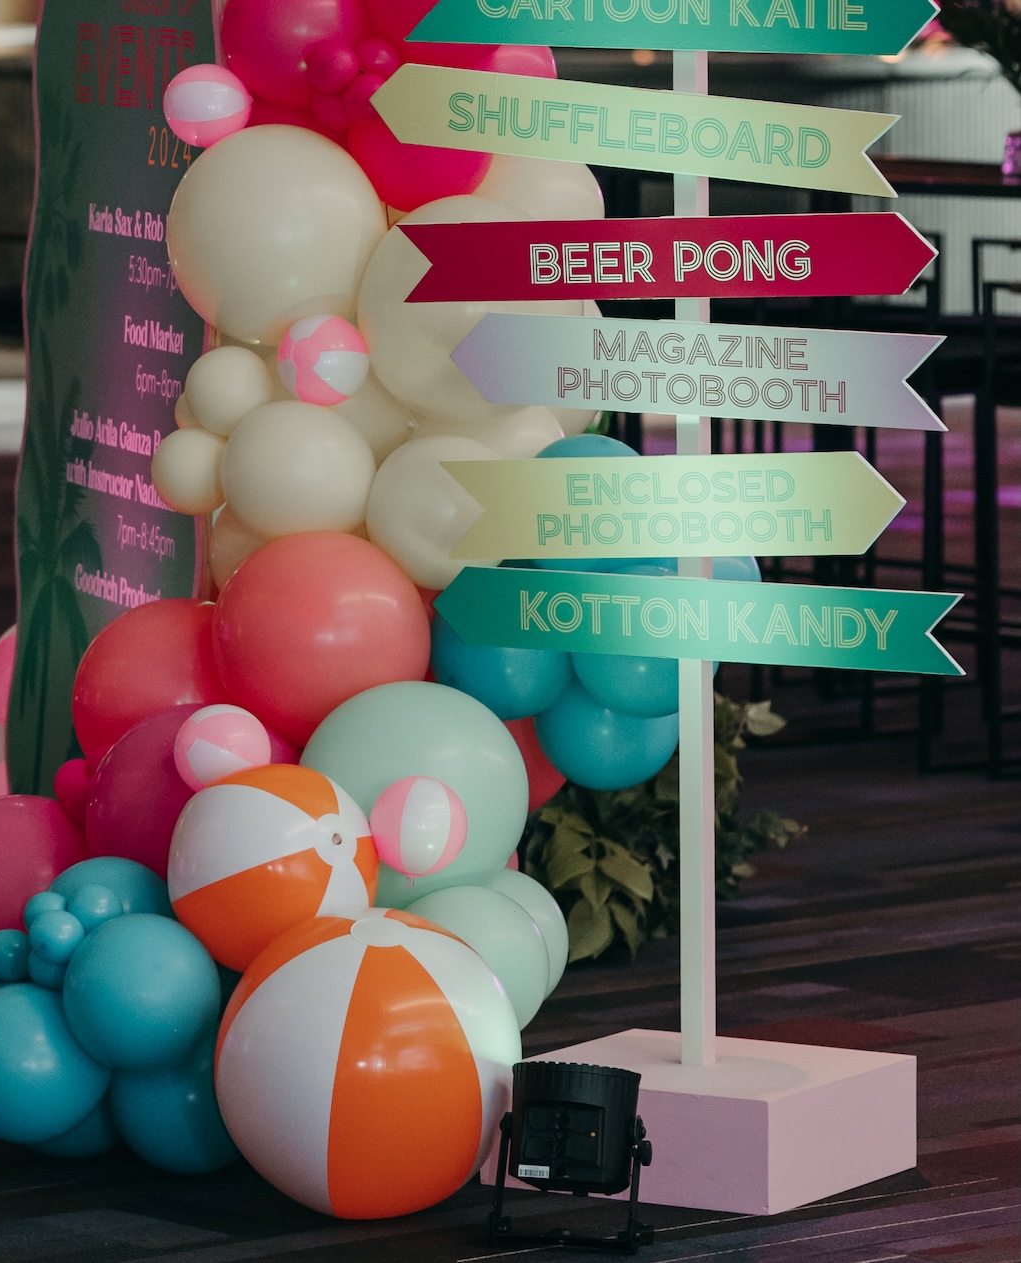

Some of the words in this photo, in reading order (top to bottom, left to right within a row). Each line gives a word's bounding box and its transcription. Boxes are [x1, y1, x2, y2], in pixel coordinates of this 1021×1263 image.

[447, 92, 831, 170] SHUFFLEBOARD
[89, 203, 113, 234] Karla
[115, 207, 132, 237] Sax
[134, 210, 143, 239] &
[144, 211, 164, 242] Rob
[128, 255, 178, 297] 5:30pm-7p
[530, 242, 656, 285] BEER
[674, 240, 812, 282] PONG
[123, 315, 148, 349] Food
[149, 320, 184, 355] Market
[593, 329, 808, 371] MAGAZINE
[136, 364, 182, 405] 6pm-8pm
[558, 368, 846, 414] PHOTOBOOTH
[119, 421, 152, 456] Gainza
[88, 461, 133, 500] Instructor
[566, 470, 795, 506] ENCLOSED
[117, 515, 175, 562] 7pm-8:45pm
[536, 509, 832, 547] PHOTOBOOTH
[75, 563, 117, 604] Goodrich
[519, 589, 710, 640] KOTTON
[728, 602, 899, 651] KANDY
